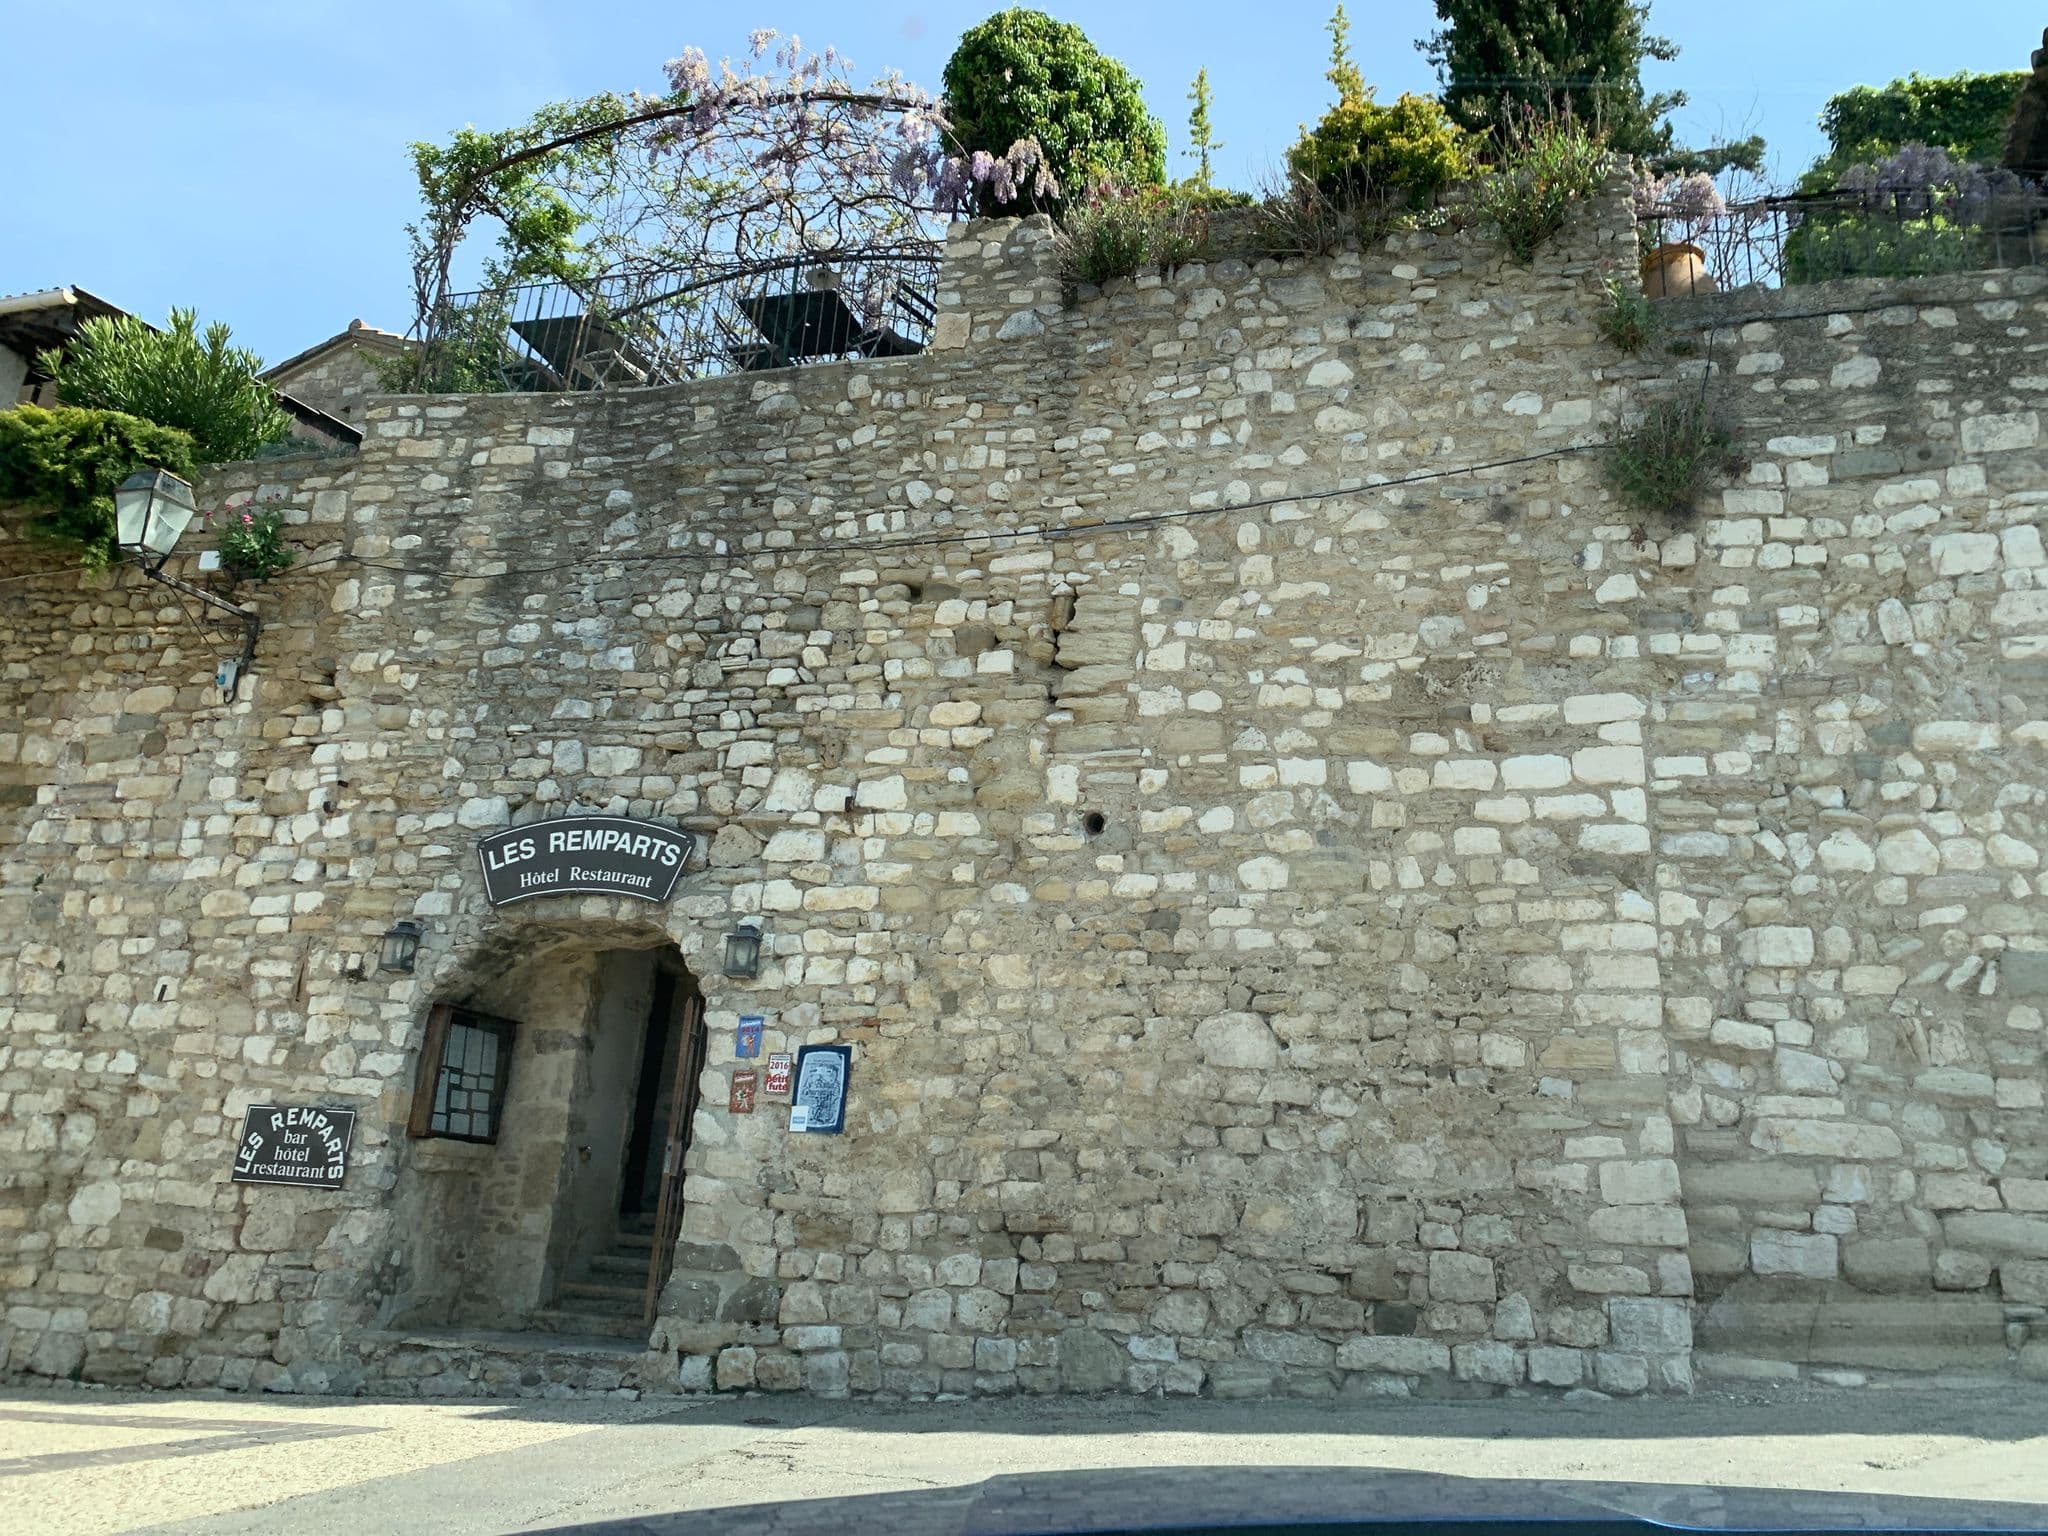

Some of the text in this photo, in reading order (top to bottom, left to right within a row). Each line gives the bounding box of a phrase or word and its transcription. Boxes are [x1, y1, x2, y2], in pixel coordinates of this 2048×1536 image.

[488, 830, 681, 871] LES REMPARTS
[519, 866, 653, 889] Hôtel Restaurant
[770, 1061, 789, 1070] 2016
[766, 1073, 789, 1085] petit
[234, 1108, 344, 1179] LES REMPARTS
[284, 1129, 308, 1144] bar
[274, 1145, 310, 1162] hôtel
[252, 1162, 325, 1179] restaurant
